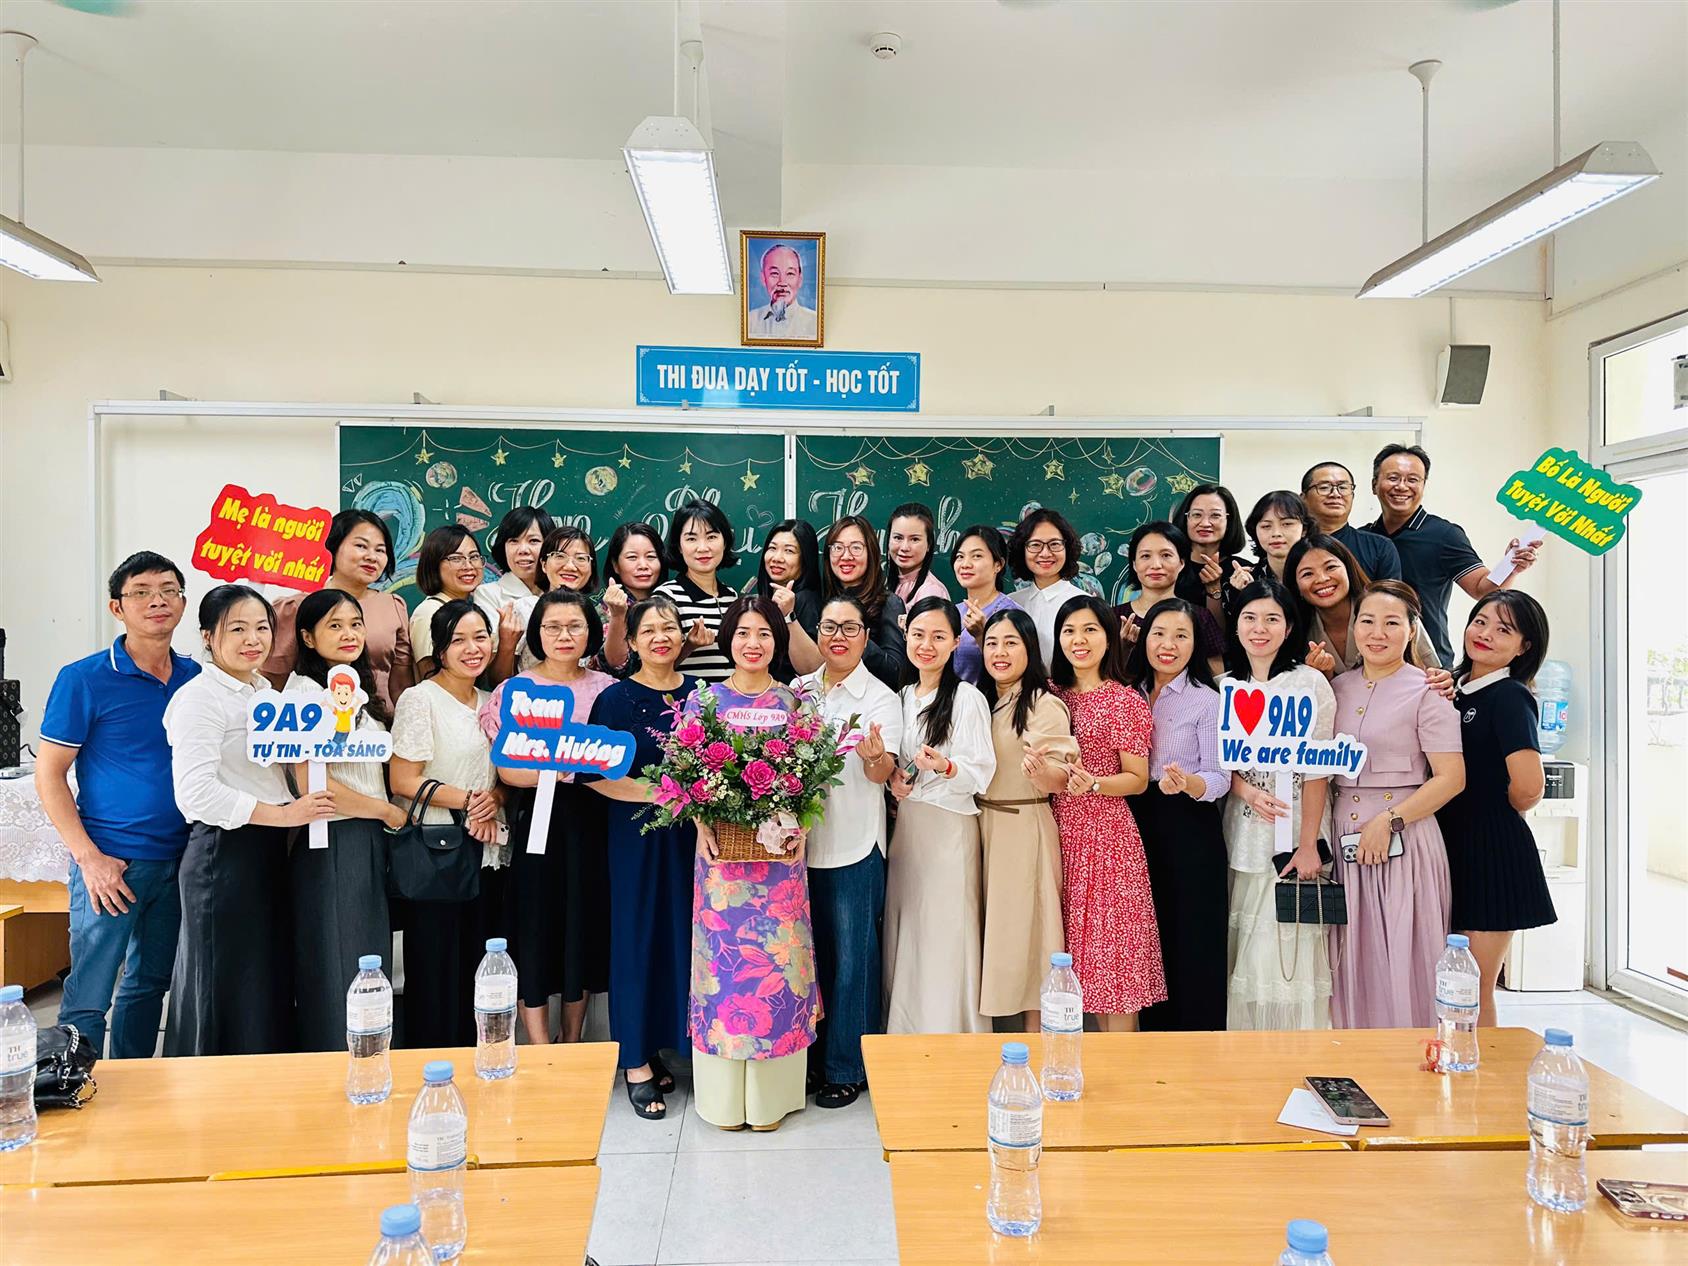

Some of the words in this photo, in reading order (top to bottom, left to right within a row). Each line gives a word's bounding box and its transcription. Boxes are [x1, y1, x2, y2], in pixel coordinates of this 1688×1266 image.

[657, 365, 685, 389] THI
[691, 366, 729, 391] ĐUA
[734, 367, 770, 396] DẠY
[776, 360, 807, 392] TỐT
[826, 369, 862, 399] HỌC
[868, 362, 899, 394] TỐT
[1536, 455, 1569, 478] Bố
[1556, 467, 1583, 489] Là
[1577, 477, 1633, 513] Người
[218, 497, 249, 530] Mẹ
[250, 505, 272, 529] là
[272, 517, 325, 542] người
[1505, 479, 1551, 512] Tuyệt
[1545, 500, 1578, 526] Vời
[1568, 515, 1616, 547] Nhất
[200, 537, 252, 571] tuyệt
[253, 550, 284, 573] vời
[282, 556, 325, 583] nhất
[253, 702, 322, 731] 9A9
[510, 690, 565, 729] Team
[726, 711, 751, 720] CMHS
[1220, 685, 1234, 731] I
[1268, 694, 1312, 737] 9A9
[253, 741, 275, 762] TỰ
[276, 744, 301, 757] TIN
[347, 740, 387, 757] SÁNG
[501, 731, 551, 761] Mrs.
[1222, 738, 1252, 763] We
[1257, 746, 1291, 765] are
[1296, 740, 1363, 773] family
